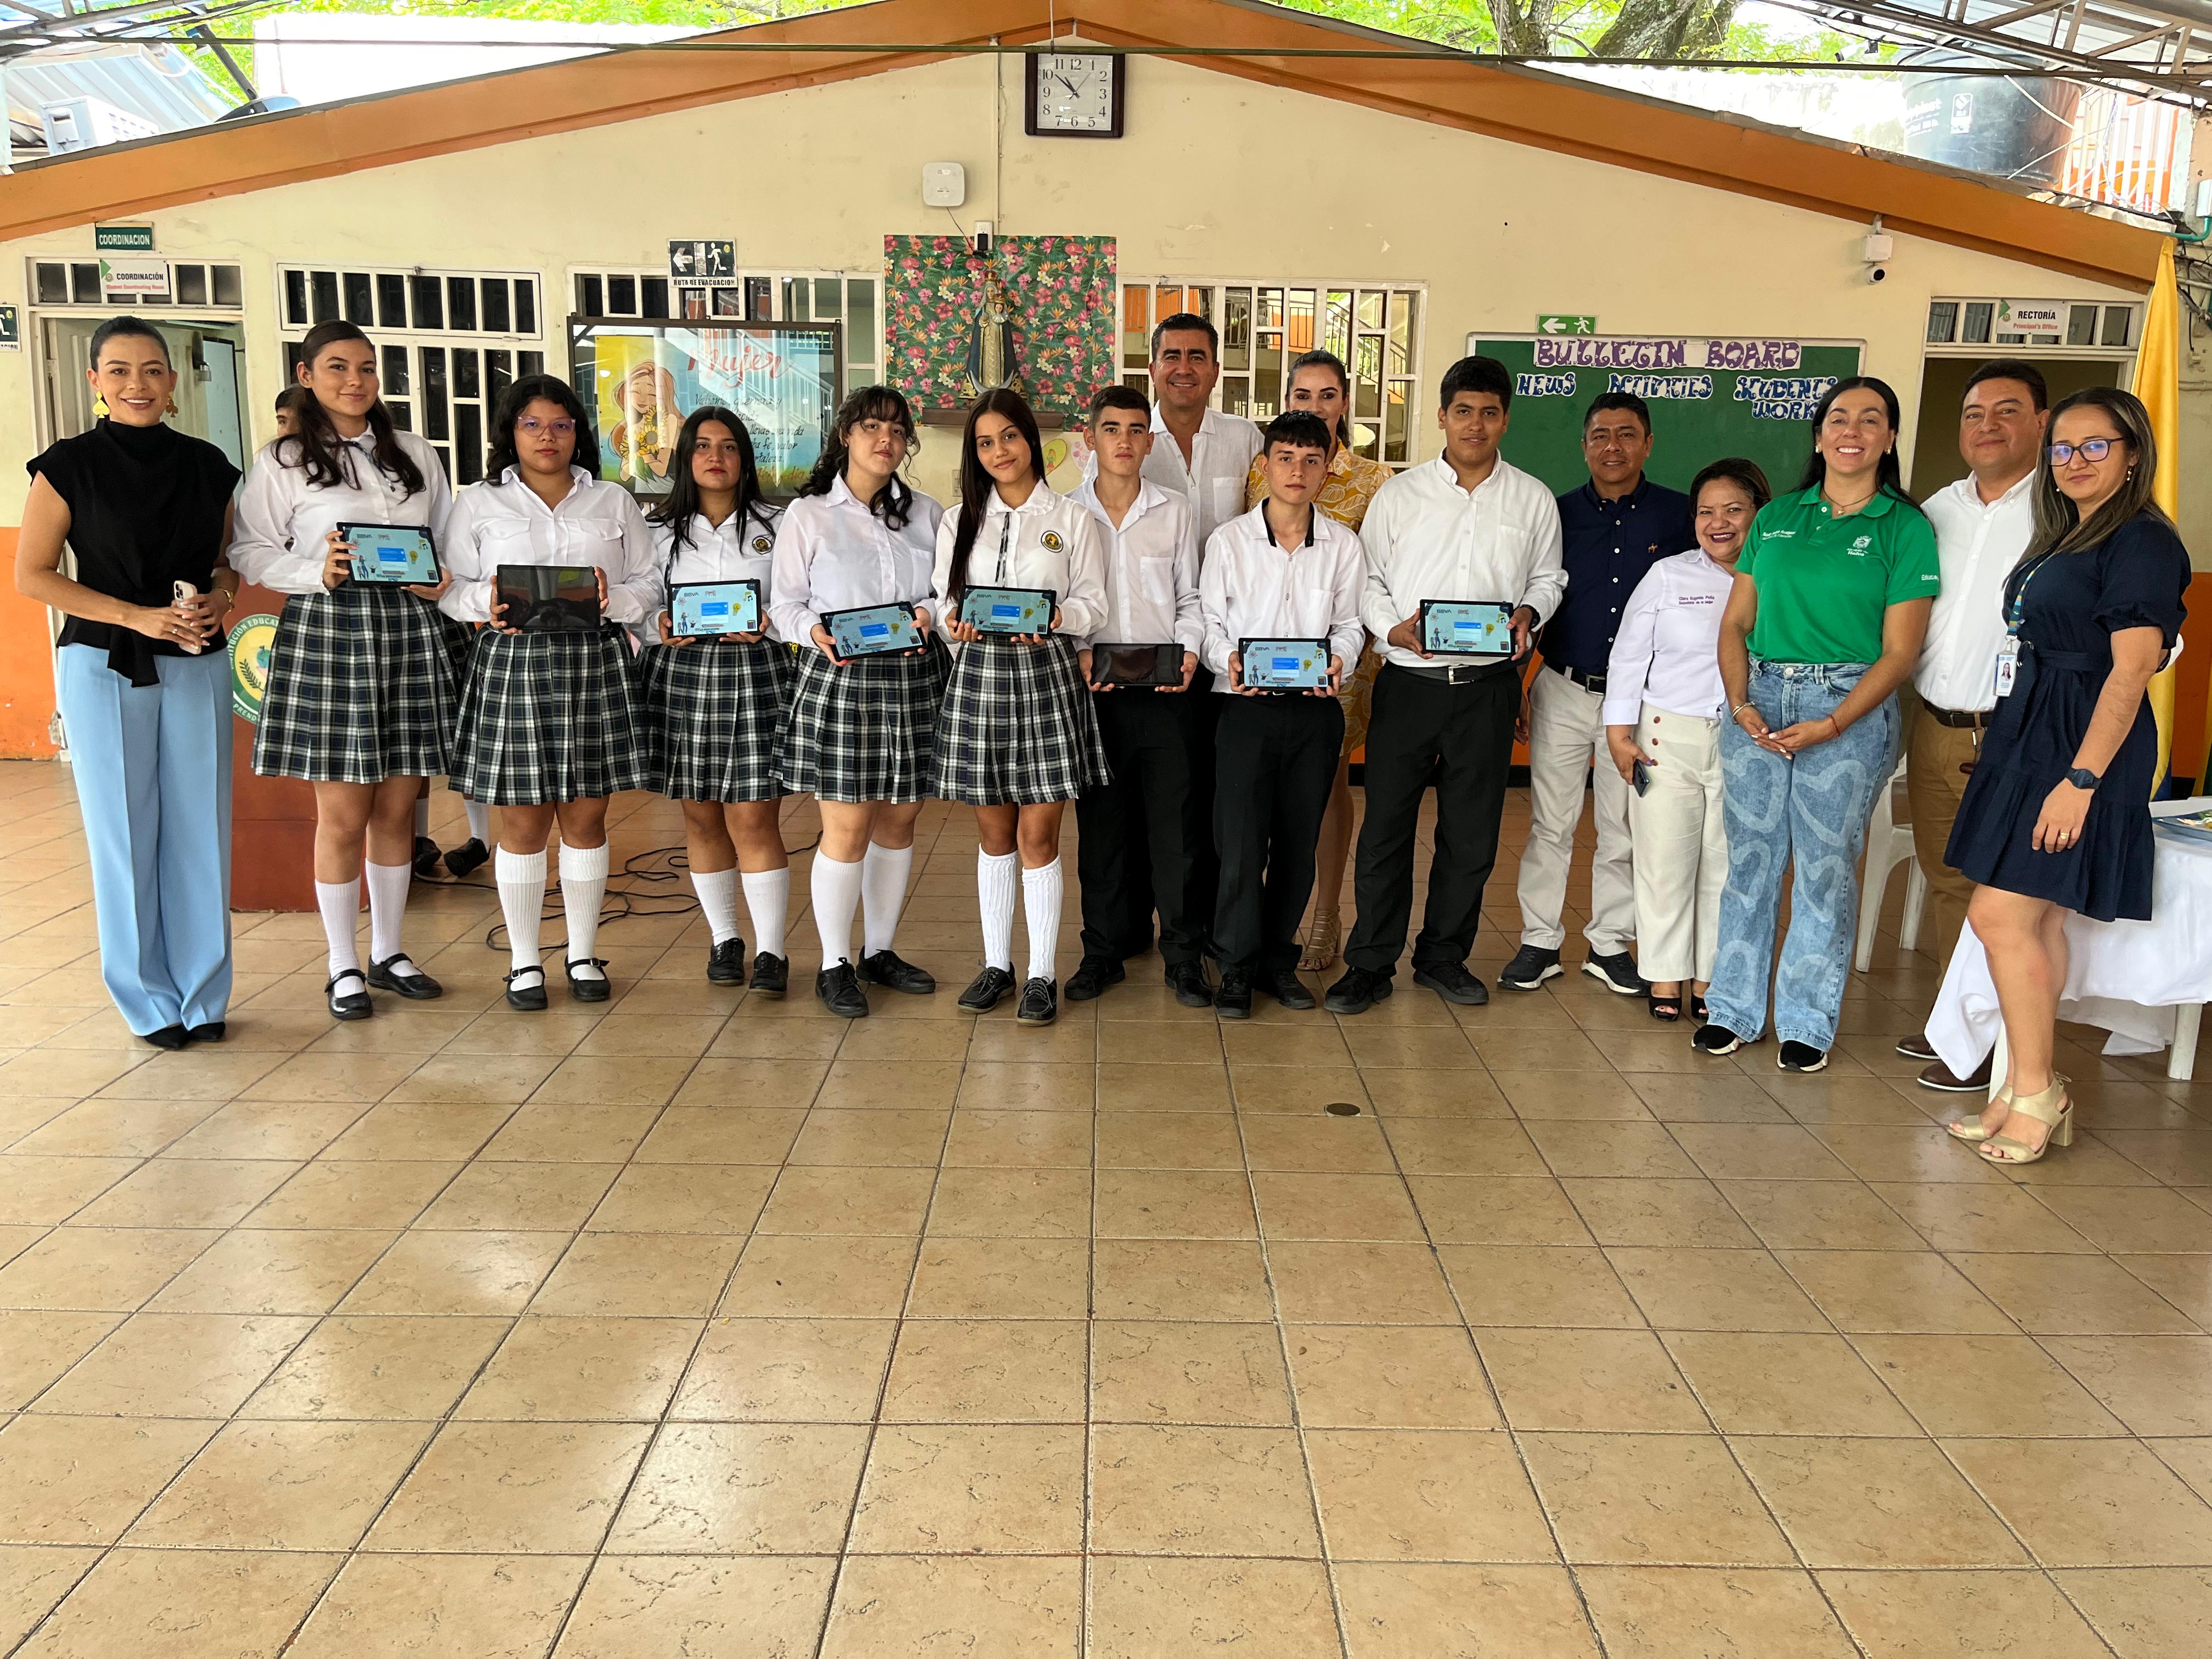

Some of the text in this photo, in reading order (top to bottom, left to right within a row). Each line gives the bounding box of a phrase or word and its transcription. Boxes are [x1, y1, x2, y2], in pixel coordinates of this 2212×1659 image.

[1056, 59, 1064, 70] 11
[1070, 59, 1081, 70] 12
[1091, 60, 1094, 70] 1
[1042, 69, 1053, 80] 10
[1099, 70, 1107, 82] 2
[1043, 87, 1051, 98] 9
[1099, 88, 1107, 99] 3
[1043, 104, 1051, 115] 8
[1098, 106, 1107, 117] 4
[1055, 115, 1062, 126] 7
[1071, 116, 1079, 127] 6
[1088, 117, 1096, 127] 5
[99, 234, 150, 245] COORDINACION
[116, 272, 163, 280] COORDINACIÓN
[2018, 309, 2056, 320] RECTORÍA
[1537, 338, 1800, 370] BULLETIN BOARD
[687, 345, 794, 390] Mujer
[1517, 373, 1576, 396] NEWS
[1609, 374, 1712, 398] ACTIVITIES
